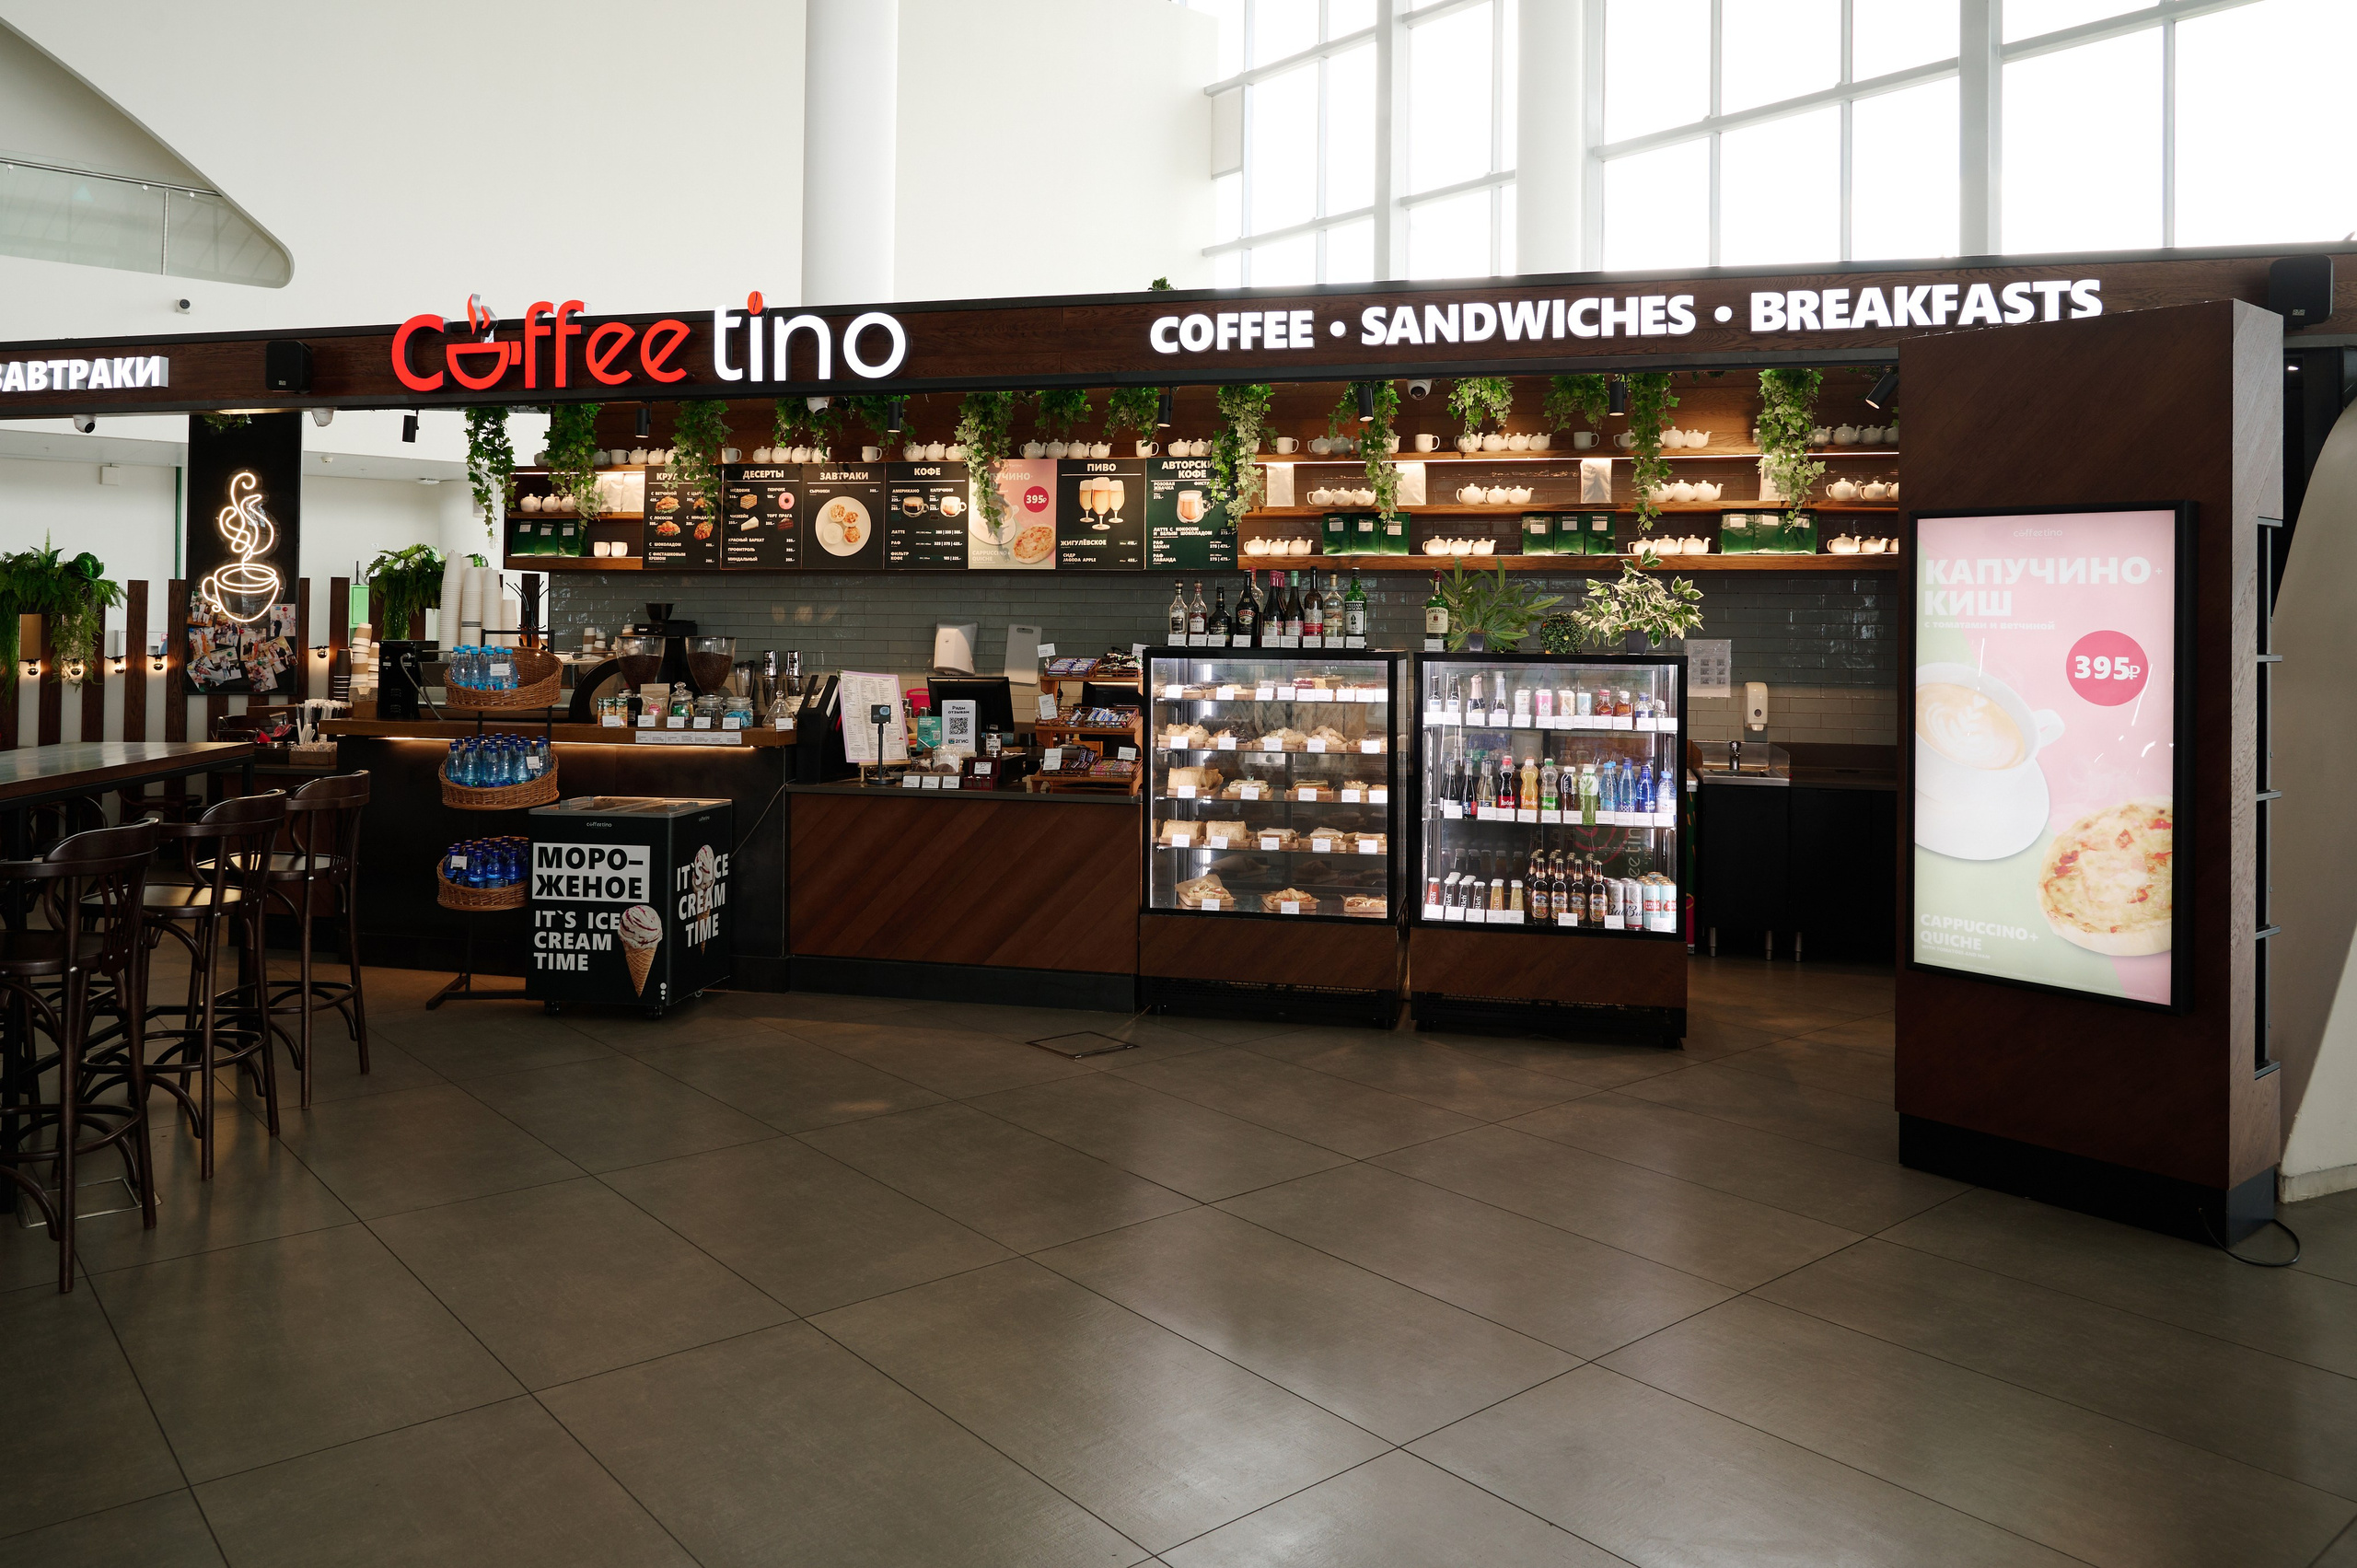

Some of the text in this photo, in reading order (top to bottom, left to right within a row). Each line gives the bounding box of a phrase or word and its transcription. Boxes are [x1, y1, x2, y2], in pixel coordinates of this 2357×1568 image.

[1150, 280, 2104, 354] COFFEE SANDWICHES BREAKFASTS
[391, 291, 910, 391] Coffee tino
[914, 468, 941, 476] КОФЕ
[1087, 463, 1117, 471] ПИВО
[1162, 460, 1214, 470] АВТОРСКИ
[1178, 470, 1206, 478] КОФЕ
[743, 470, 784, 480] ДЕСЕРТЫ
[819, 472, 869, 481] ЗАВТРАКИ
[989, 472, 1031, 481] ПУЧИНО
[1924, 590, 2012, 616] КИШ
[2001, 621, 2055, 630] ветчиной
[711, 853, 729, 882] ICE
[535, 874, 643, 900] ЖЕНОЕ
[678, 882, 726, 921] CREAM
[587, 912, 621, 930] ICE
[685, 913, 719, 947] TIME
[534, 932, 612, 951] CREAM
[1920, 930, 1981, 951] QUICHE
[533, 952, 588, 971] TIME
